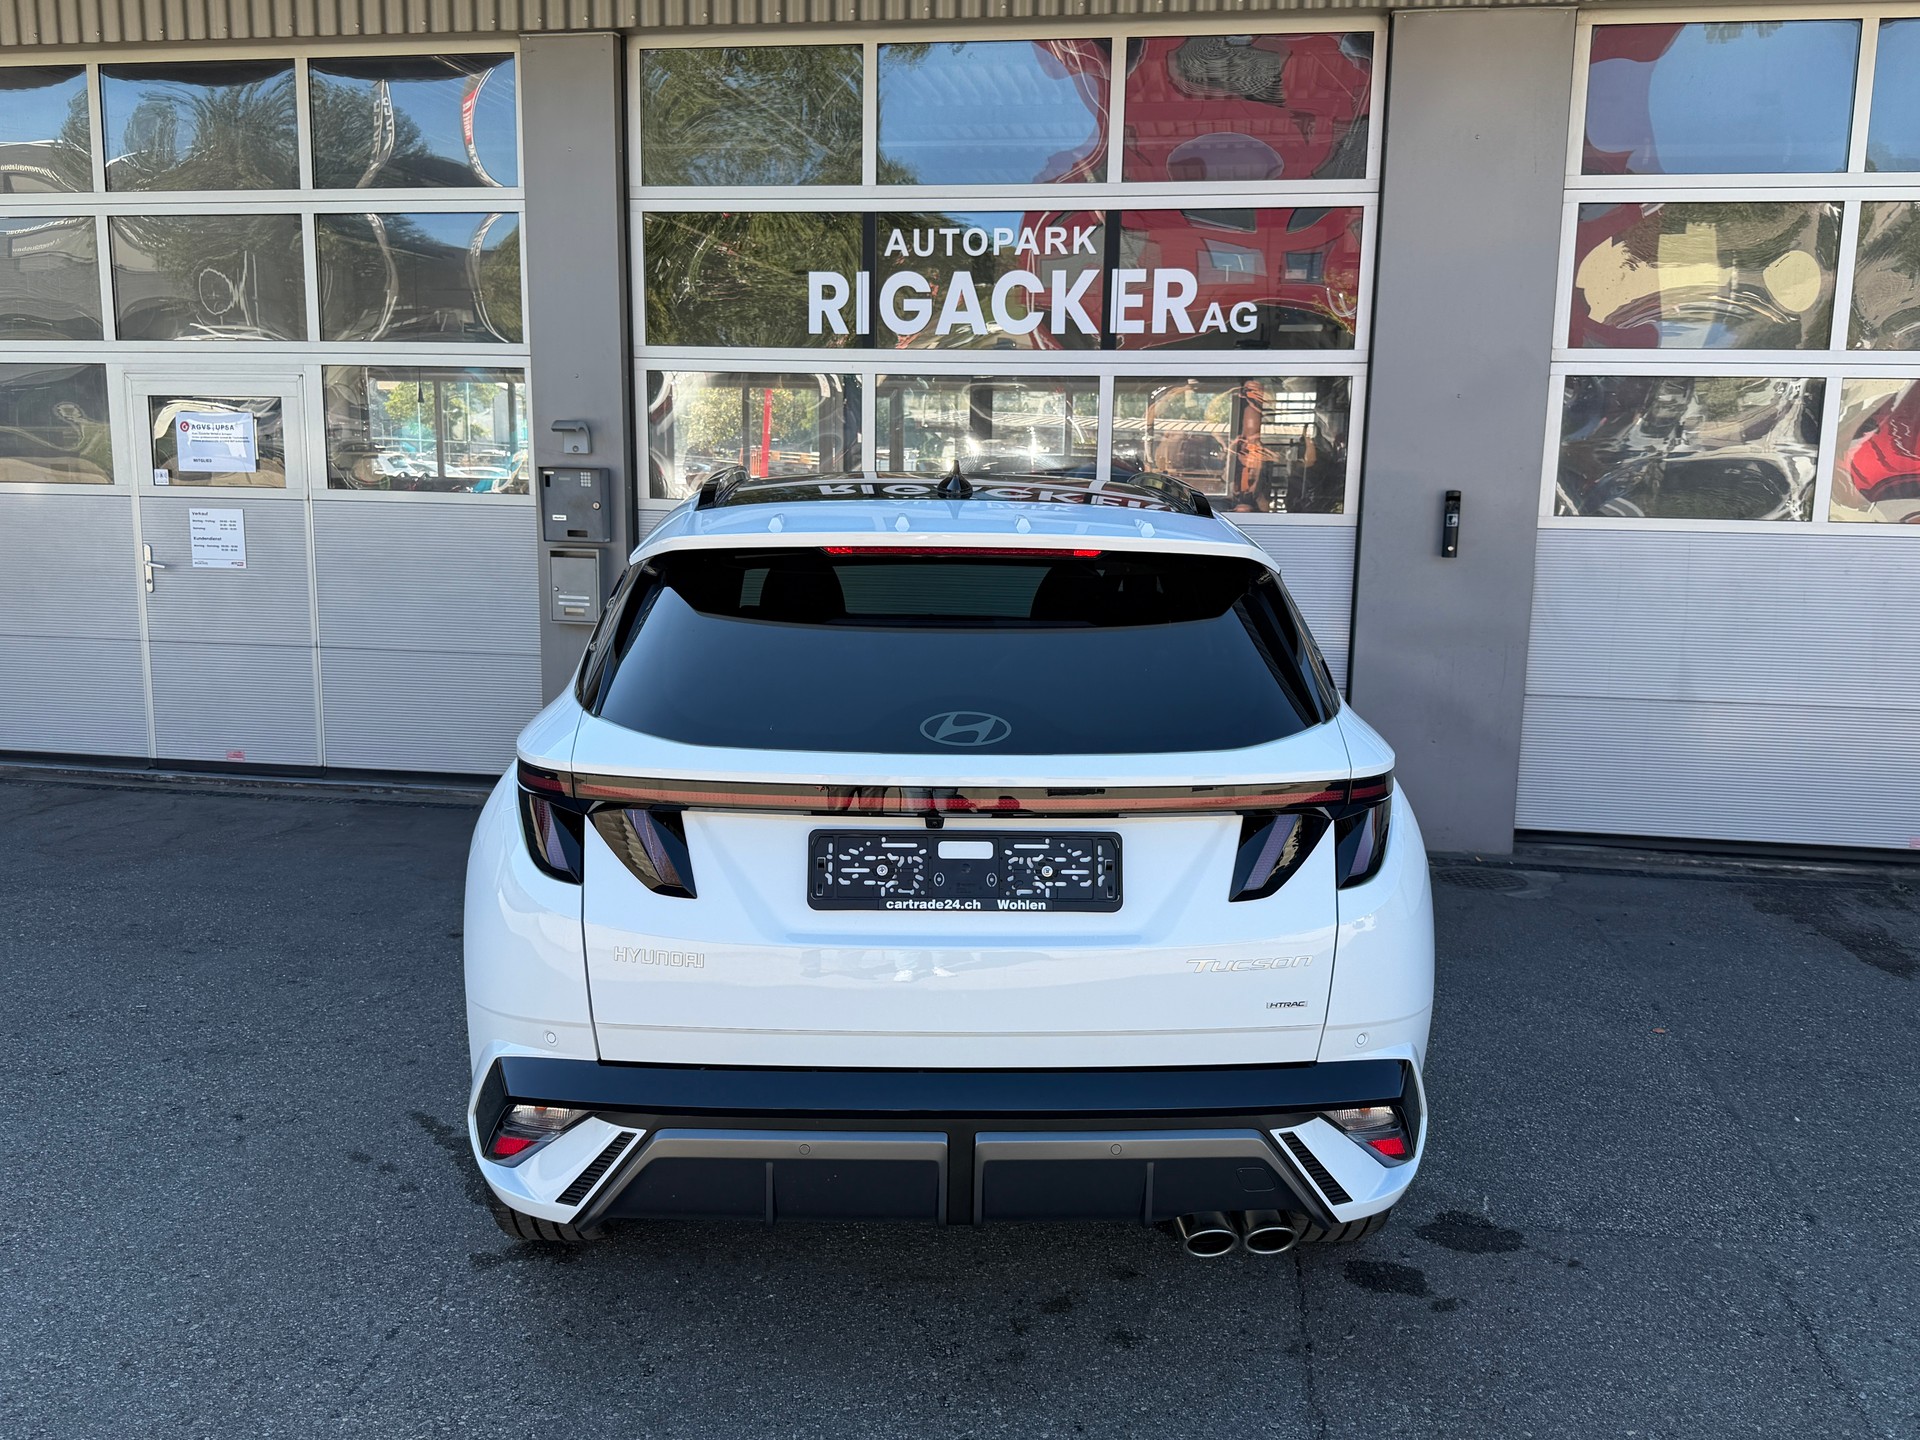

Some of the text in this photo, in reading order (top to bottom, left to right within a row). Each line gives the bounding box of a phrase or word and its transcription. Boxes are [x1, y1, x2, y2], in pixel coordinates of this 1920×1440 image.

[884, 226, 1097, 257] AUTOPARK
[808, 268, 1259, 336] RIGACKER AG
[885, 899, 1047, 911] cartrade24.ch Wohlen
[613, 946, 705, 968] HYUNDAI
[1269, 1000, 1306, 1009] HTRAC
